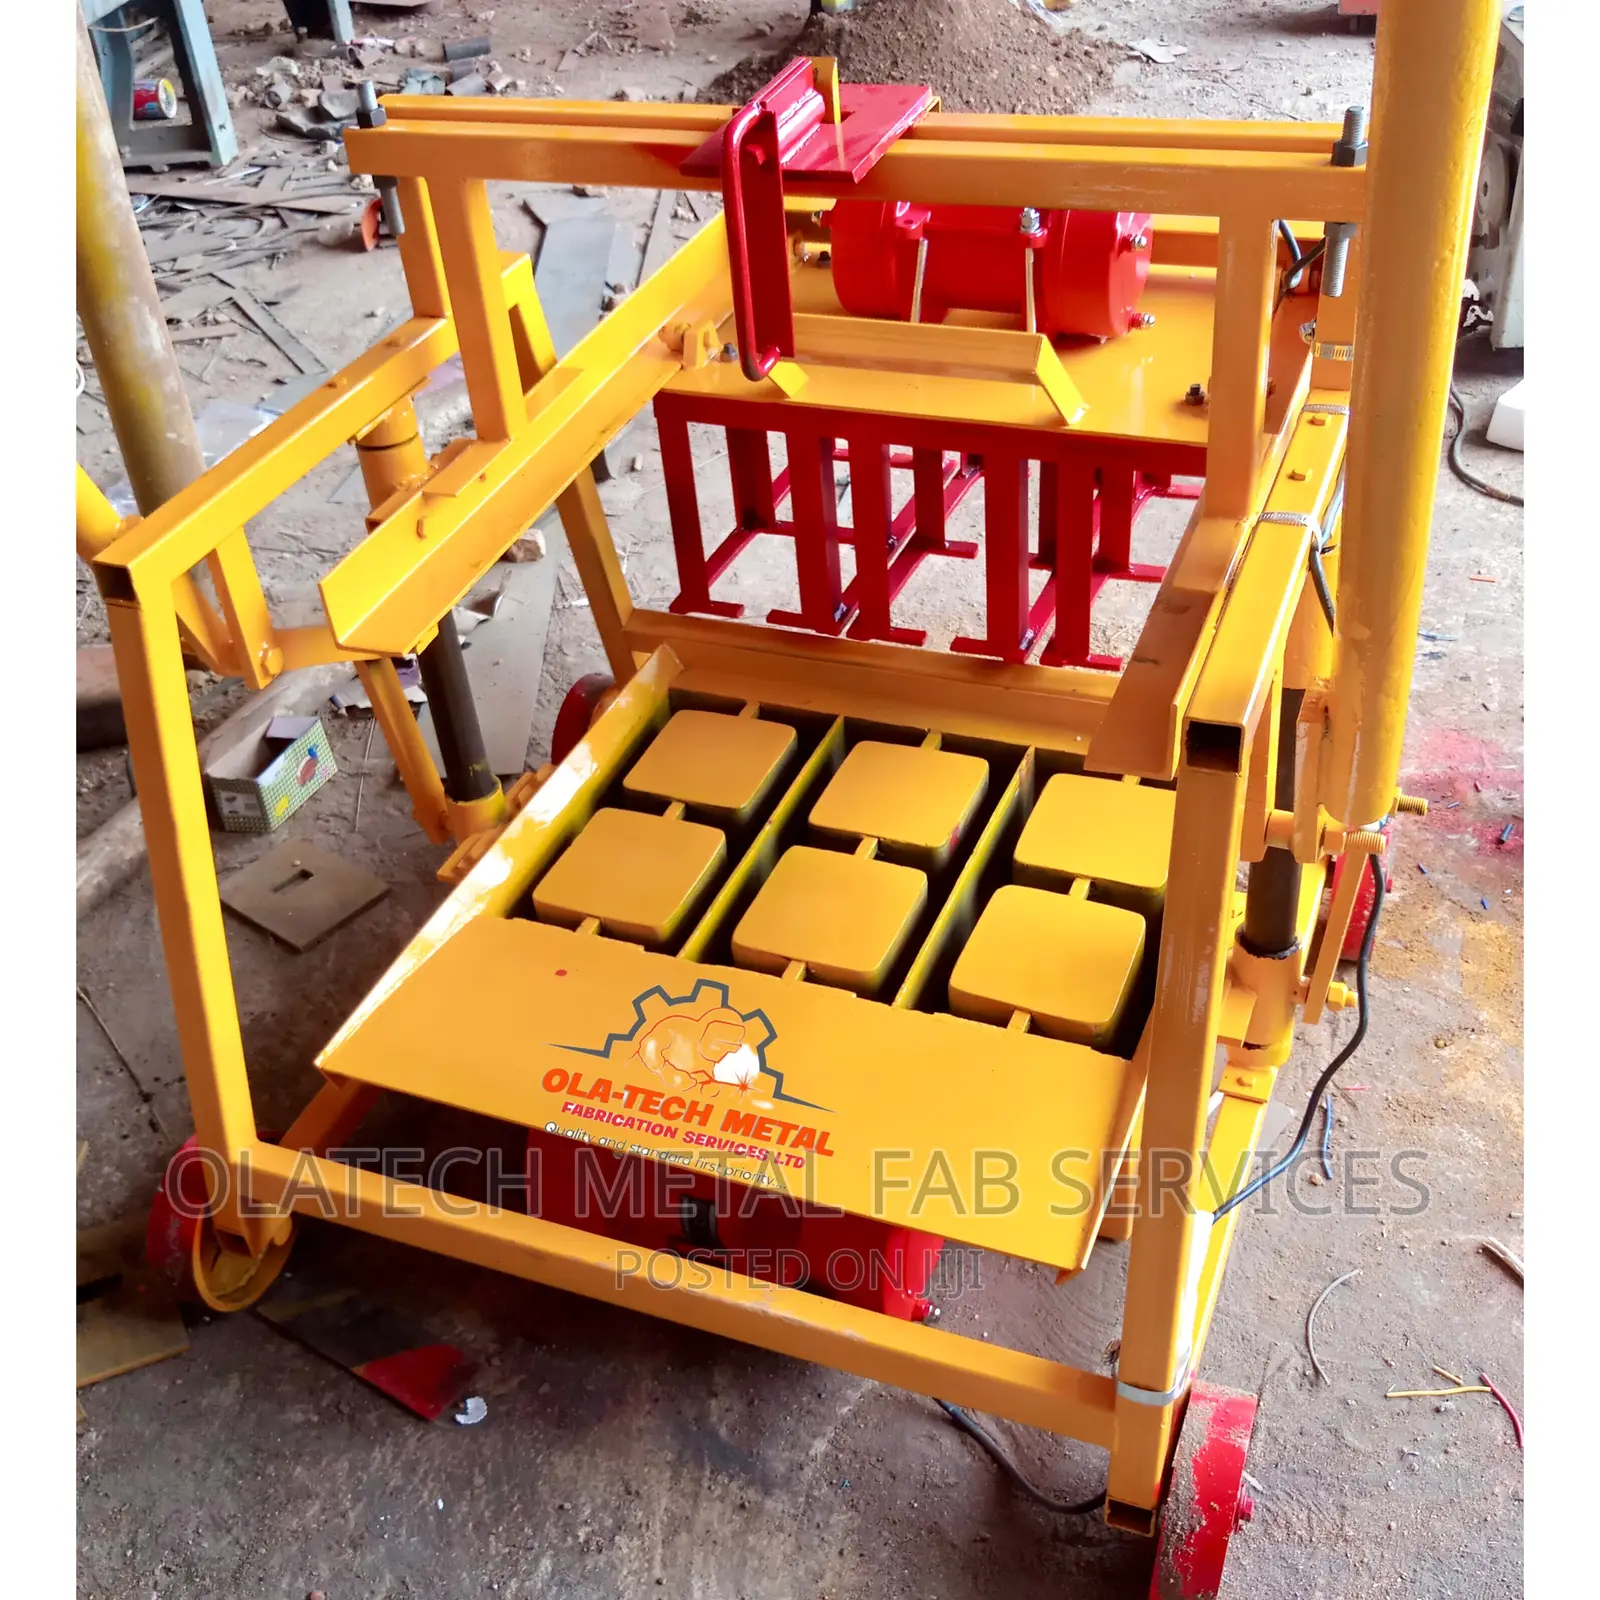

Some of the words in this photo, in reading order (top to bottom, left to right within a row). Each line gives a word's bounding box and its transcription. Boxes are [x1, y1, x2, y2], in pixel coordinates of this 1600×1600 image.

[542, 1068, 713, 1126] OLA-TECH
[720, 1109, 834, 1157] METAL
[561, 1101, 679, 1139] FABRICATION
[682, 1131, 769, 1161] SERVICES
[774, 1151, 805, 1169] LTD
[544, 1121, 595, 1145] Quality
[598, 1136, 627, 1150] and
[630, 1142, 691, 1166] standard
[694, 1155, 721, 1173] first
